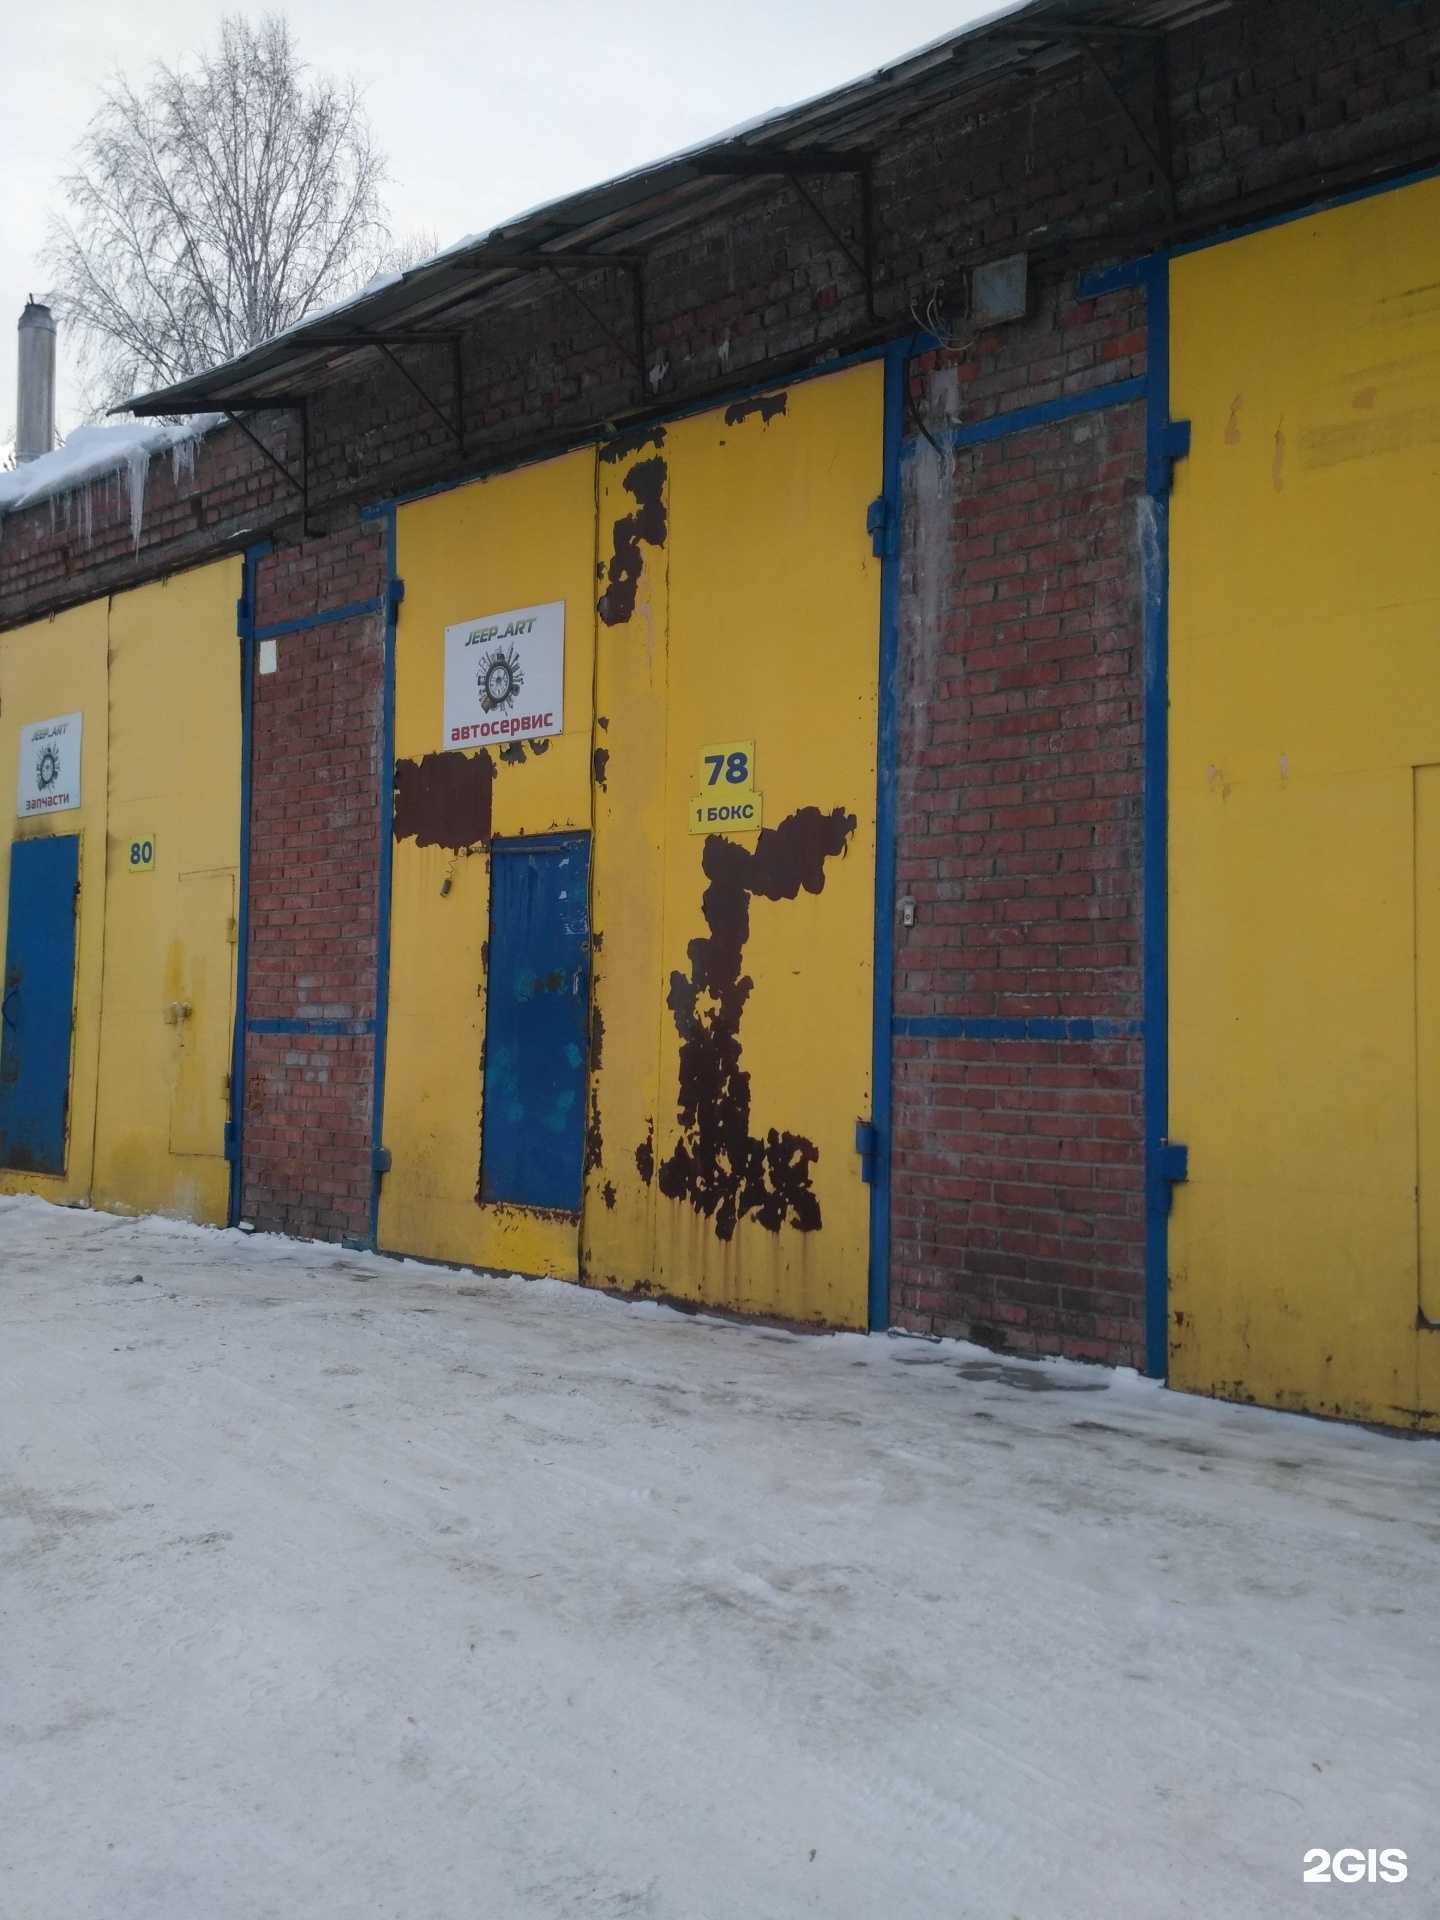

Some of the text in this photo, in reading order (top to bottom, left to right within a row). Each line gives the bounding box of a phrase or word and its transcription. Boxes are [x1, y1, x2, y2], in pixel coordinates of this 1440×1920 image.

[464, 617, 537, 647] JEEP_ART
[450, 712, 553, 742] автосервис
[704, 752, 748, 786] 78
[25, 792, 70, 811] запчасти
[696, 804, 754, 823] 1 БОКС
[130, 841, 153, 865] 80
